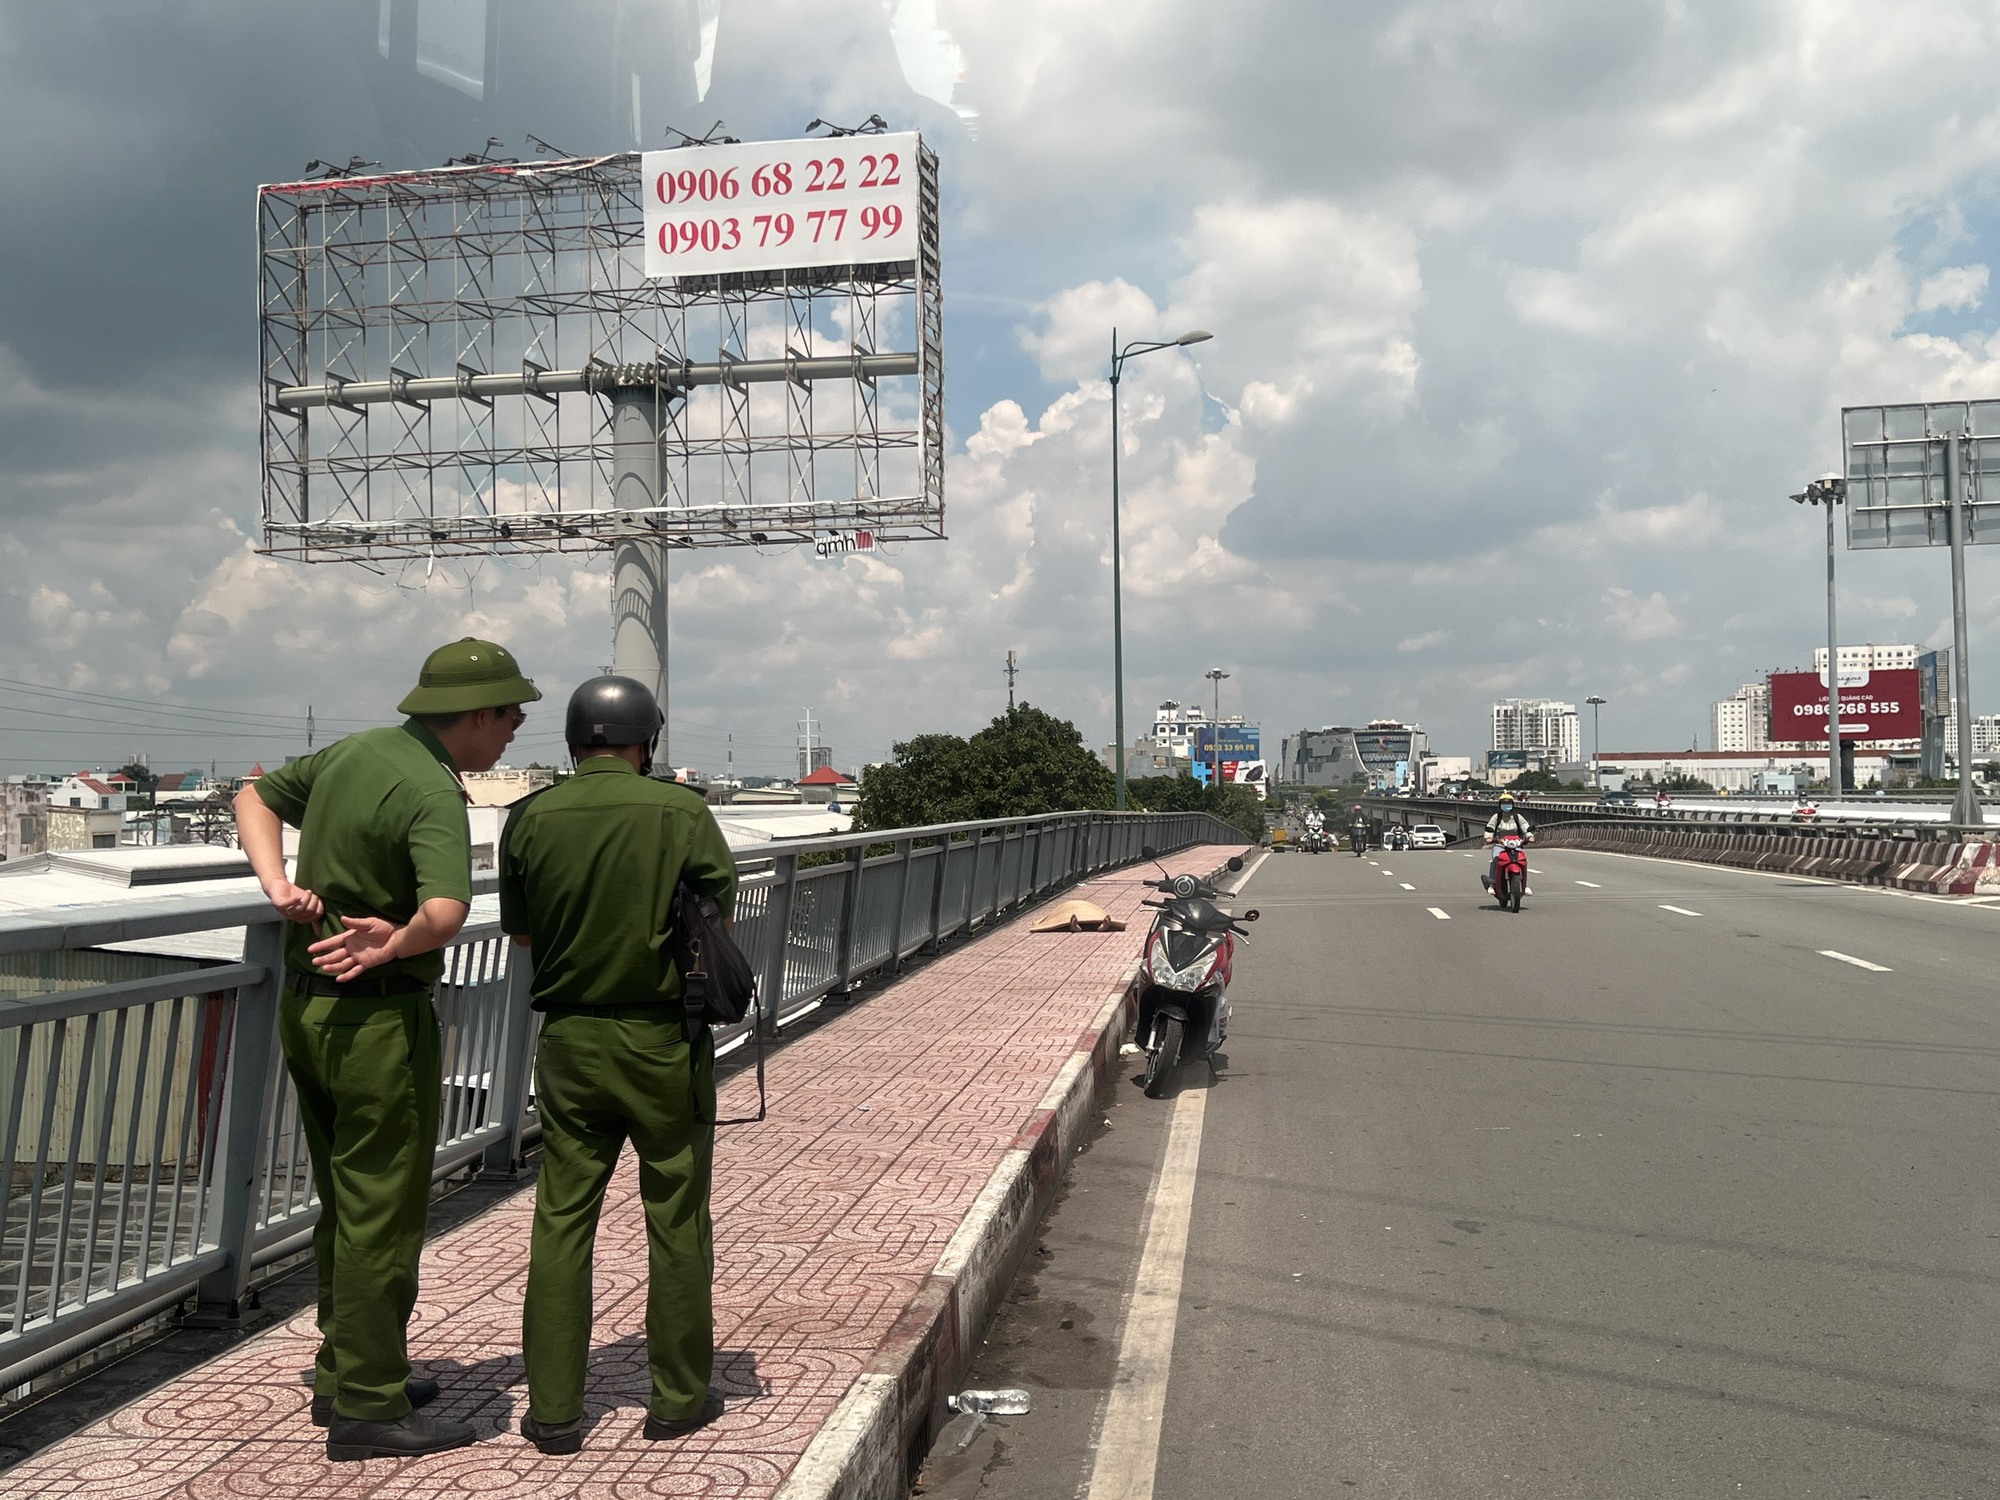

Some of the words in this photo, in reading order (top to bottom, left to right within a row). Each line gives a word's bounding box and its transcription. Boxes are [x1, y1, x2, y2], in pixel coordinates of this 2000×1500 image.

[656, 166, 739, 205] 0906
[751, 161, 793, 197] 68
[804, 157, 847, 193] 22
[858, 152, 902, 189] 22
[658, 217, 742, 255] 0903
[752, 212, 795, 248] 79
[806, 208, 848, 244] 77
[860, 204, 903, 241] 99
[1793, 703, 1830, 716] 0986
[1837, 702, 1867, 715] 268
[1870, 701, 1900, 714] 555
